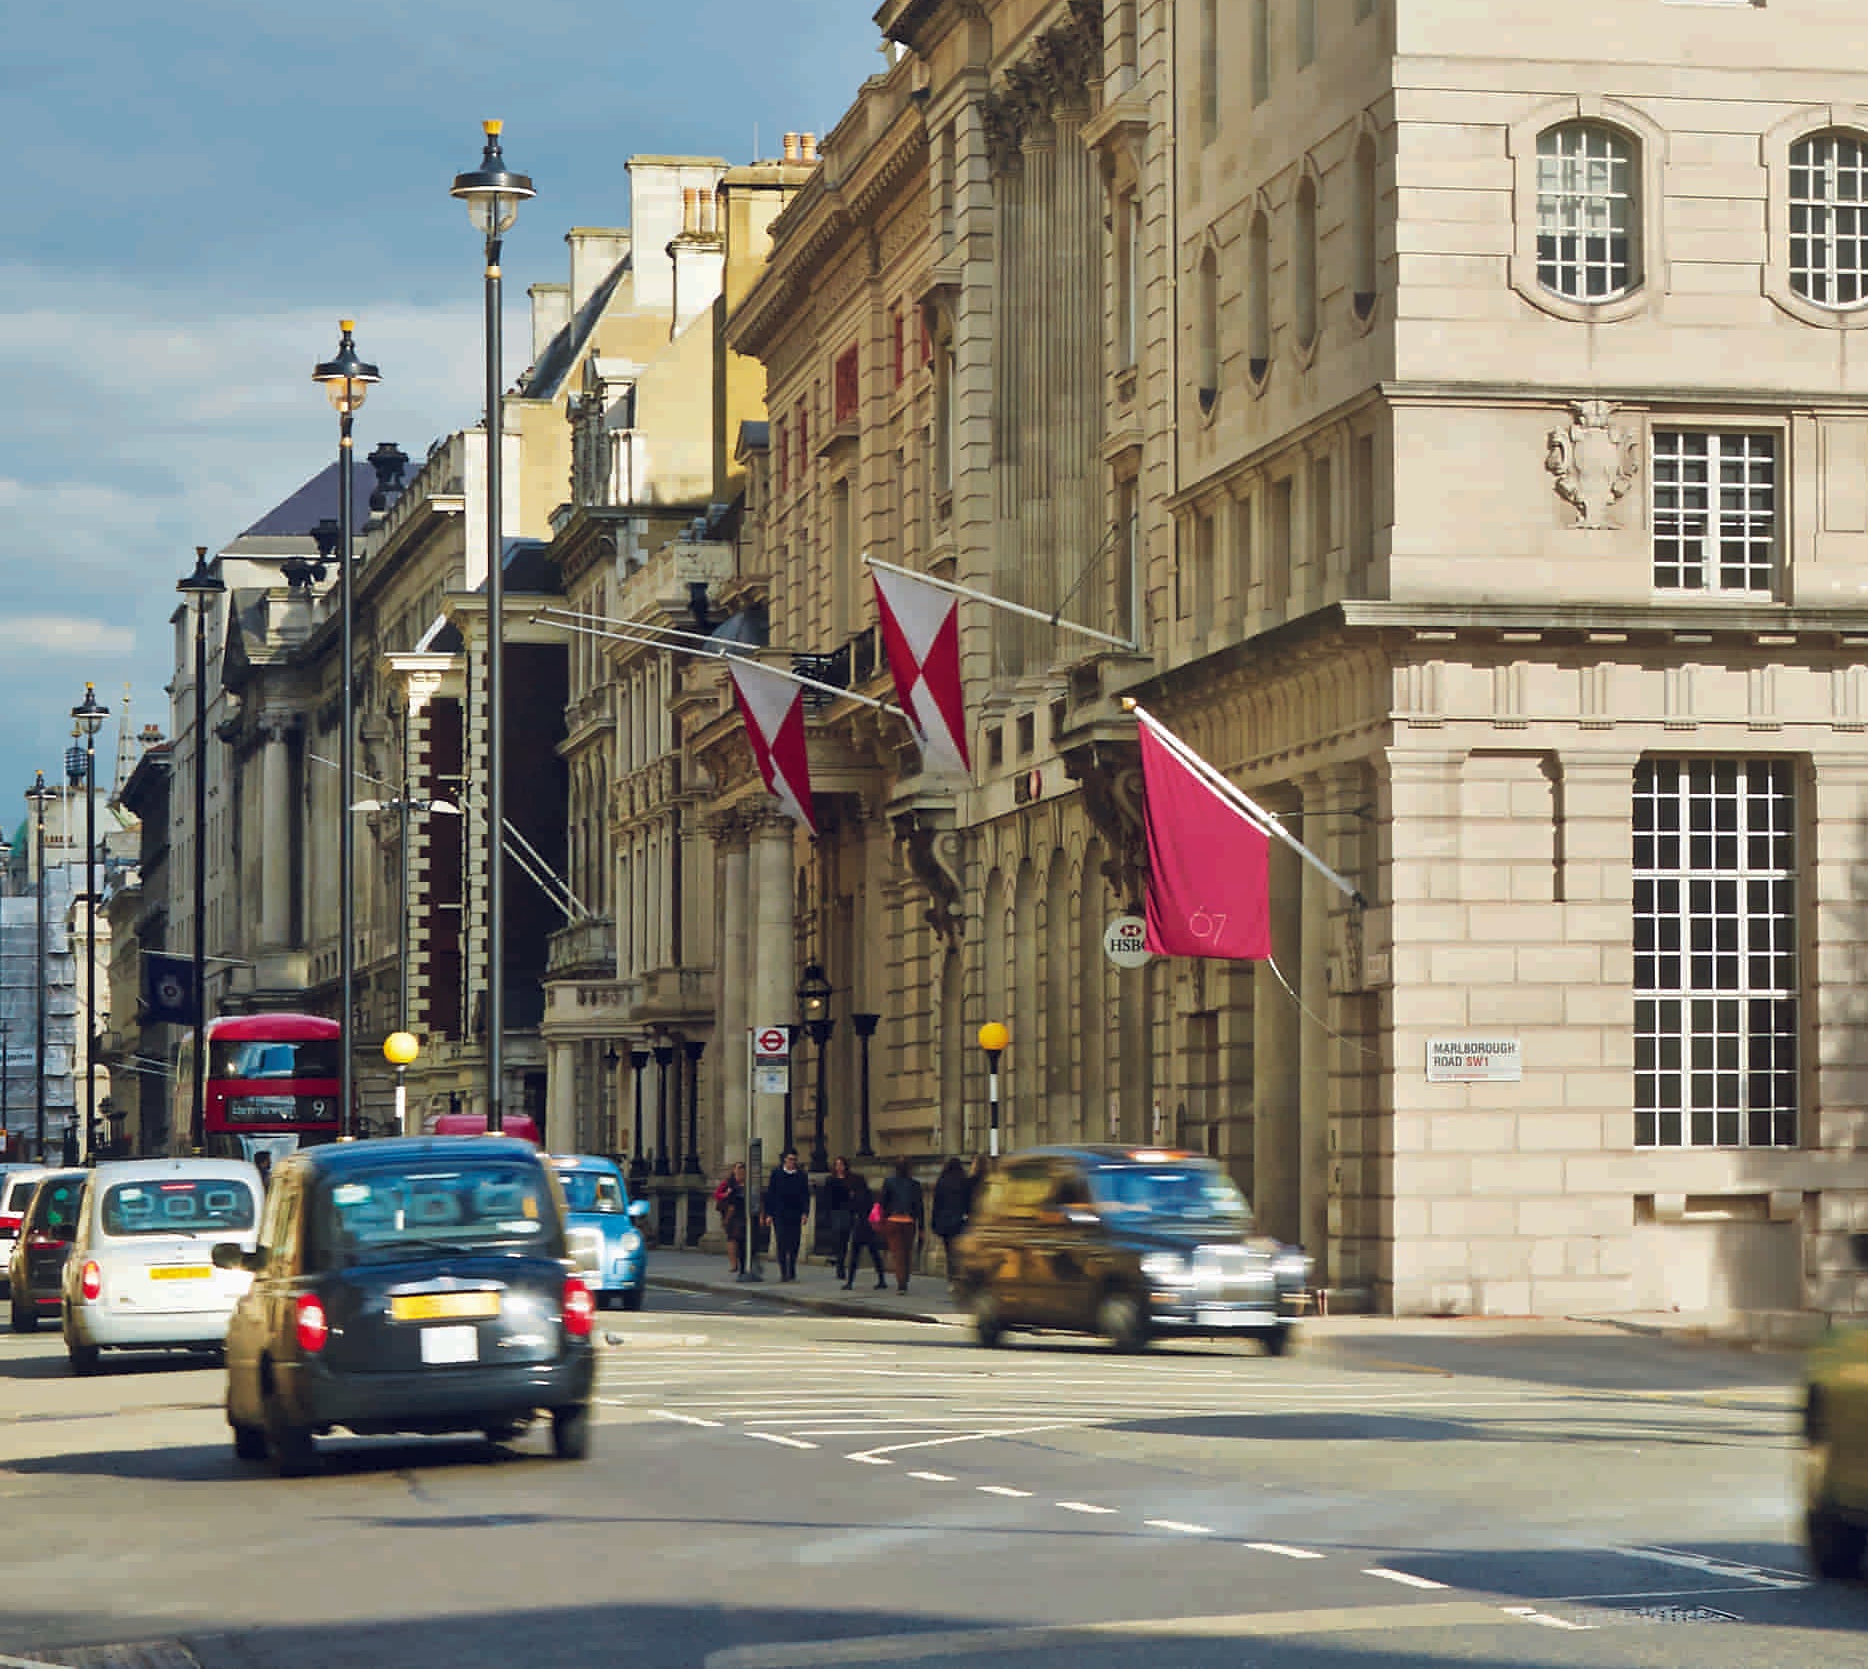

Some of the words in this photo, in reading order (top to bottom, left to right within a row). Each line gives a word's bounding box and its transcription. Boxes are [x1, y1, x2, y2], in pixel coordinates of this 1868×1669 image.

[1434, 1041, 1514, 1055] MARLBOROUGH
[1434, 1056, 1463, 1067] ROAD
[1466, 1056, 1489, 1067] SW1
[312, 1098, 325, 1117] 9
